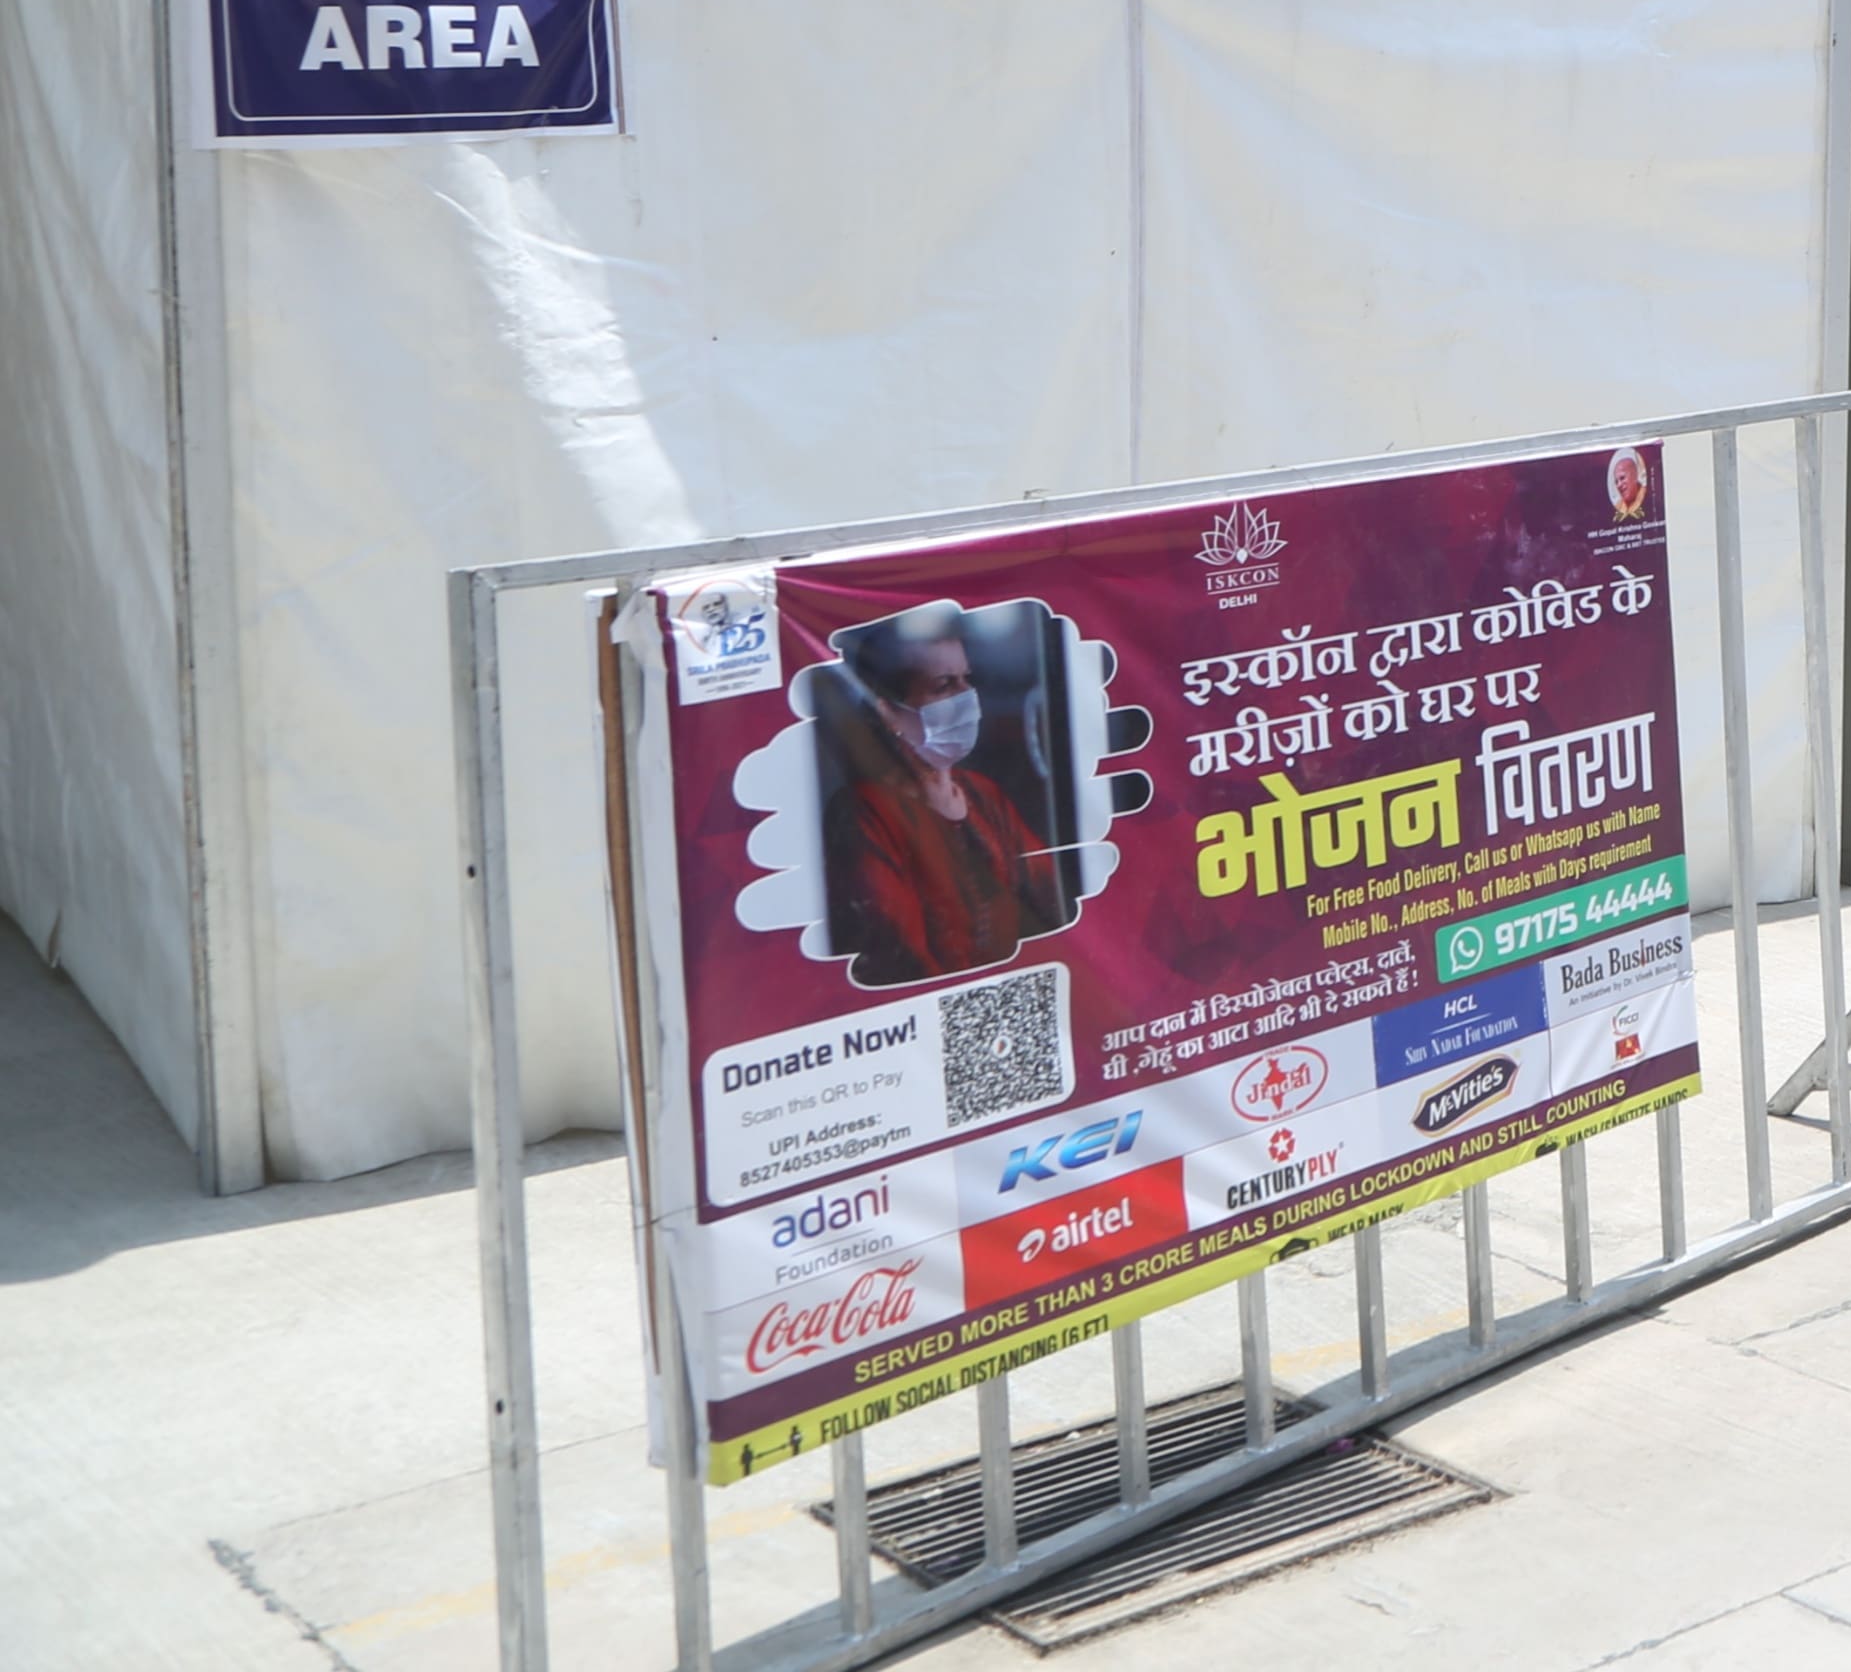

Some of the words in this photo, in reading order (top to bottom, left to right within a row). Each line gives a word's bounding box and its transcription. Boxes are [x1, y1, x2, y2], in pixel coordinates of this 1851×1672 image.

[299, 4, 540, 71] AREA
[1206, 566, 1279, 592] ISKCON
[1218, 593, 1257, 610] DELHI
[1180, 624, 1359, 706] इस्कॉन
[1366, 612, 1463, 678] द्वारा
[1470, 579, 1604, 645] कोविड
[1610, 564, 1655, 616] के
[1186, 693, 1334, 777] मरीज़ों
[1341, 680, 1410, 740] को
[1417, 677, 1478, 724] घर
[1484, 663, 1542, 709] पर
[1195, 758, 1462, 898] भोजन
[1475, 711, 1656, 836] वितरण
[1306, 893, 1330, 918] For
[1333, 886, 1365, 910] Free
[1368, 874, 1401, 903] Food
[1404, 860, 1462, 891] Delivery,
[1464, 850, 1489, 874] Call
[1493, 847, 1508, 868] us
[1510, 844, 1523, 862] or
[1525, 826, 1584, 857] Whatsapp
[1586, 821, 1601, 839] us
[1602, 810, 1626, 835] with
[1628, 802, 1661, 828] Name
[1323, 918, 1368, 949] Mobile
[1370, 911, 1398, 934] No.,
[1401, 895, 1455, 927] Address,
[1457, 886, 1479, 908] No.
[1481, 881, 1495, 903] of
[1495, 871, 1531, 899] Meals
[1534, 862, 1558, 888] with
[1559, 851, 1587, 880] Days
[1589, 833, 1653, 870] requirement
[1495, 902, 1578, 956] 97175
[1585, 873, 1673, 924] 44444
[1102, 1023, 1146, 1052] आप
[1149, 1011, 1187, 1042] दान
[1188, 999, 1207, 1028] में
[1209, 973, 1312, 1021] डिस्पोजेबल
[1315, 957, 1374, 987] प्लेट्स,
[1376, 938, 1416, 969] दालें,
[1561, 955, 1604, 995] Bada
[1608, 934, 1684, 978] Business
[1102, 1053, 1128, 1081] घी
[1176, 1032, 1205, 1060] का
[1207, 1020, 1249, 1052] आटा
[1252, 1003, 1297, 1038] आदि
[1298, 994, 1323, 1023] भी
[1325, 989, 1340, 1015] दे
[1341, 973, 1394, 1007] सकते
[1443, 994, 1478, 1019] HCL
[1618, 1012, 1640, 1027] FICCI
[722, 1042, 833, 1095] Donate
[842, 1014, 918, 1059] Now!
[1404, 1045, 1428, 1066] SHIV
[1431, 1033, 1463, 1058] NADAR
[1464, 1015, 1519, 1047] FOUNDATION
[740, 1106, 784, 1129] Scan
[787, 1094, 818, 1115] this
[820, 1082, 849, 1106] QR
[852, 1079, 870, 1096] to
[872, 1069, 904, 1089] Pay
[1246, 1061, 1312, 1104] Jindal
[1428, 1064, 1504, 1127] McVitie's
[739, 1124, 912, 1188] 8527405353@paytm
[768, 1132, 800, 1157] UPI
[804, 1112, 882, 1147] Address:
[997, 1109, 1144, 1195] KEI
[772, 1174, 890, 1248] adani
[1226, 1149, 1339, 1211] CENTURYPLY
[854, 1330, 954, 1384] SERVED
[961, 1302, 1029, 1345] MORE
[1033, 1281, 1097, 1316] THAN
[1102, 1272, 1114, 1293] 3
[1119, 1242, 1195, 1287] CRORE
[1199, 1217, 1268, 1259] MEALS
[1272, 1187, 1347, 1231] DURING
[1350, 1145, 1456, 1202] LOCKDOWN
[1458, 1131, 1495, 1160] AND
[1497, 1118, 1543, 1146] STILL
[1546, 1078, 1627, 1126] COUNTING
[1050, 1196, 1135, 1253] airtel
[775, 1234, 893, 1286] Foundation
[819, 1399, 893, 1445] FOLLOW
[895, 1372, 956, 1412] SOCIAL
[959, 1332, 1059, 1389] DISTANCING
